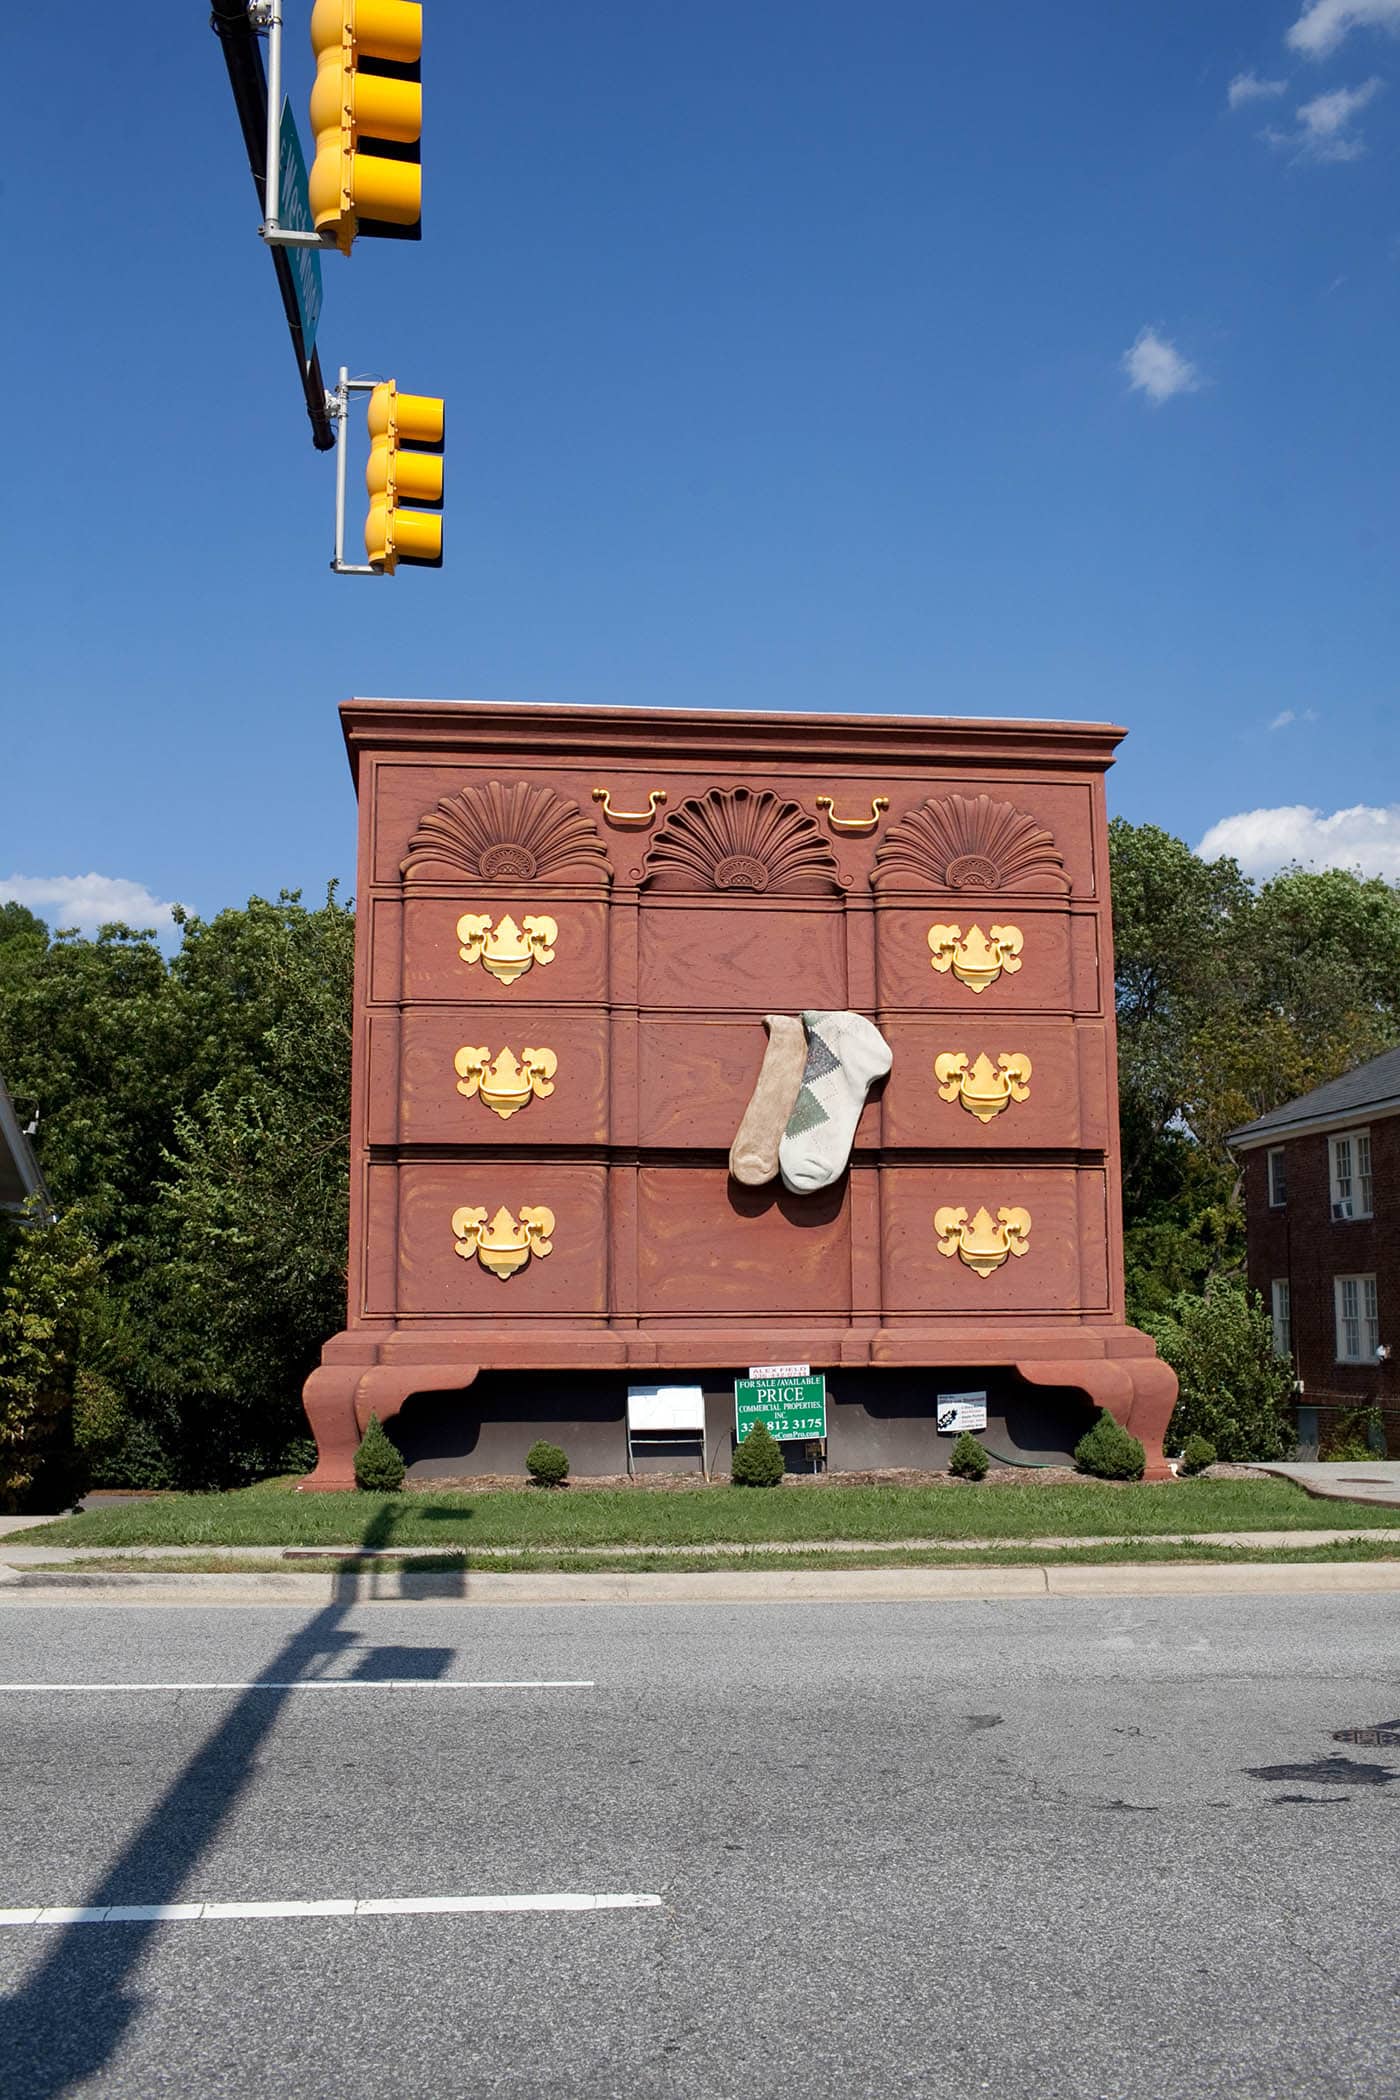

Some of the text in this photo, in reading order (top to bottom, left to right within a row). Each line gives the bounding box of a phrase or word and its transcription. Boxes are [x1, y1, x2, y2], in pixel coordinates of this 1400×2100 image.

[740, 1381, 755, 1389] FOR
[756, 1380, 776, 1388] SALE
[757, 1387, 804, 1403] PRICE
[739, 1404, 780, 1413] COMMERCIAL
[767, 1421, 789, 1431] 812
[792, 1418, 822, 1430] 3175
